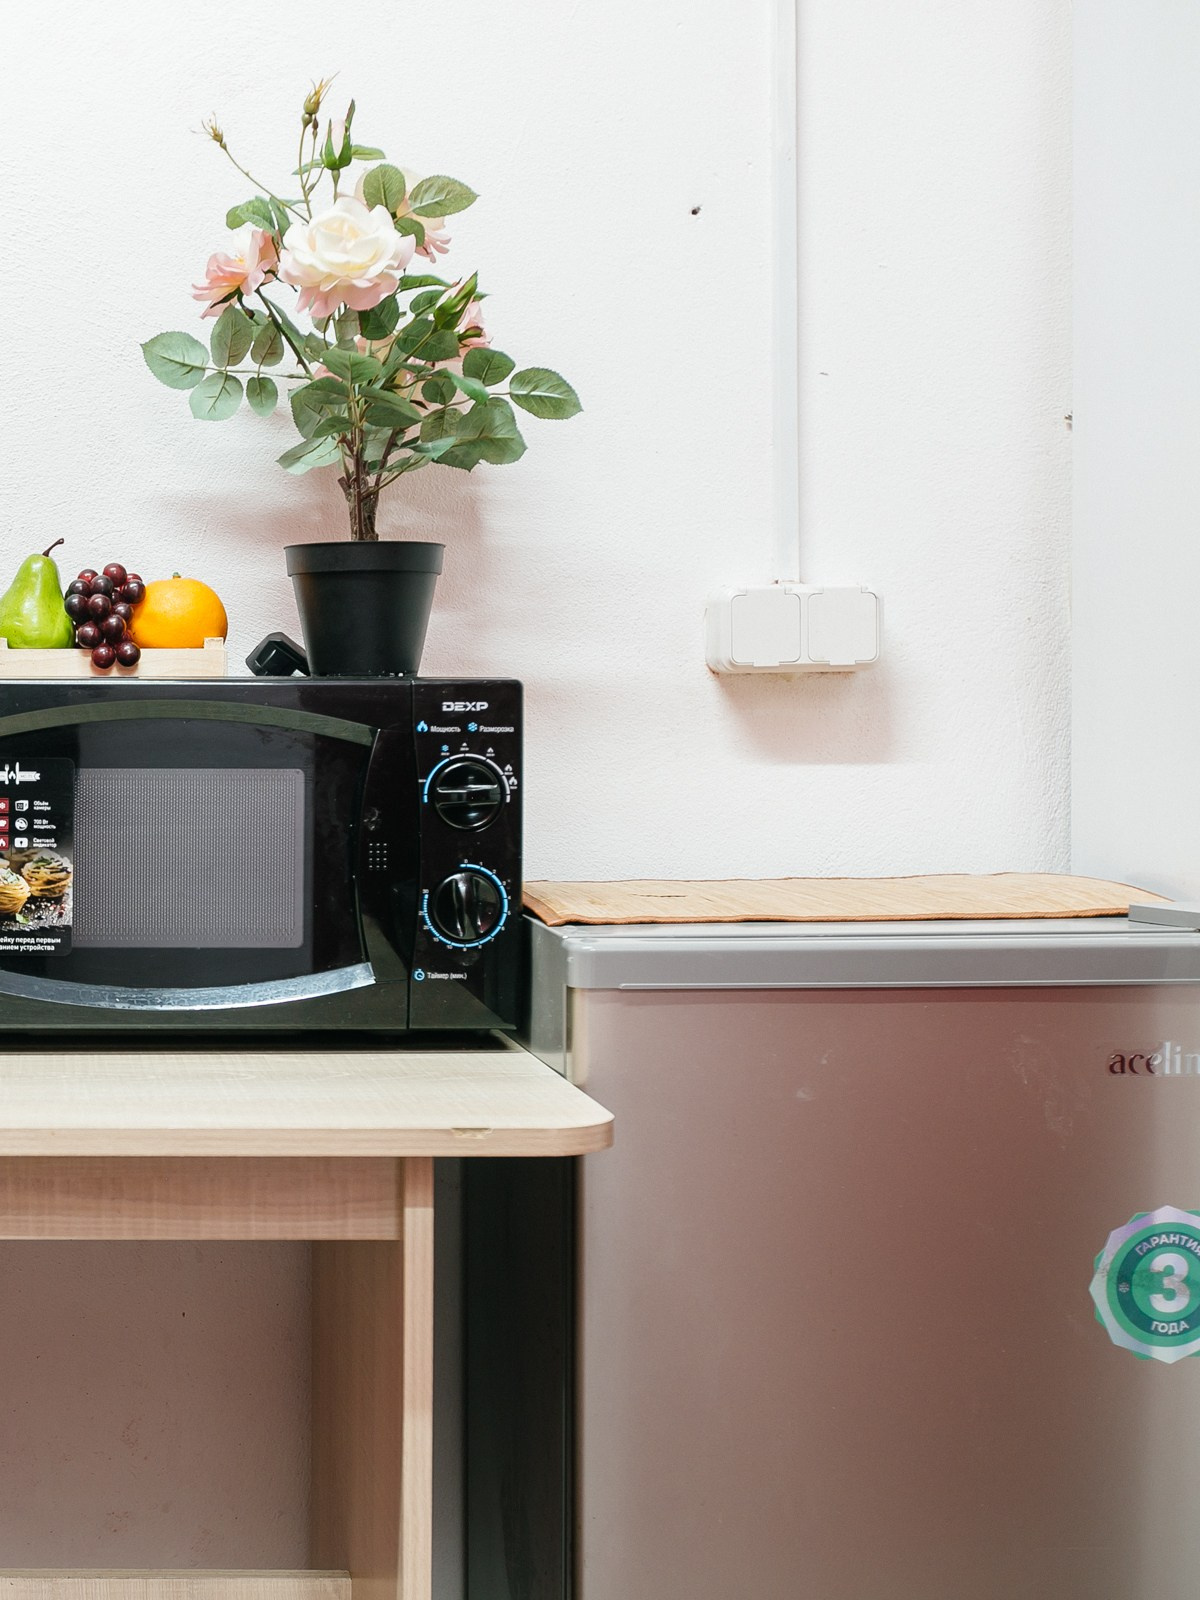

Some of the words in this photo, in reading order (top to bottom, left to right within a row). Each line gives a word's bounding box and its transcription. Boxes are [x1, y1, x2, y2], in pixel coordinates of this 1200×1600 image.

[442, 702, 489, 711] DEXP
[430, 725, 461, 733] Мощность
[479, 725, 515, 733] Разморозка
[20, 944, 55, 952] устройства
[1150, 1253, 1190, 1313] 3
[1151, 1321, 1189, 1335] ГОДА
